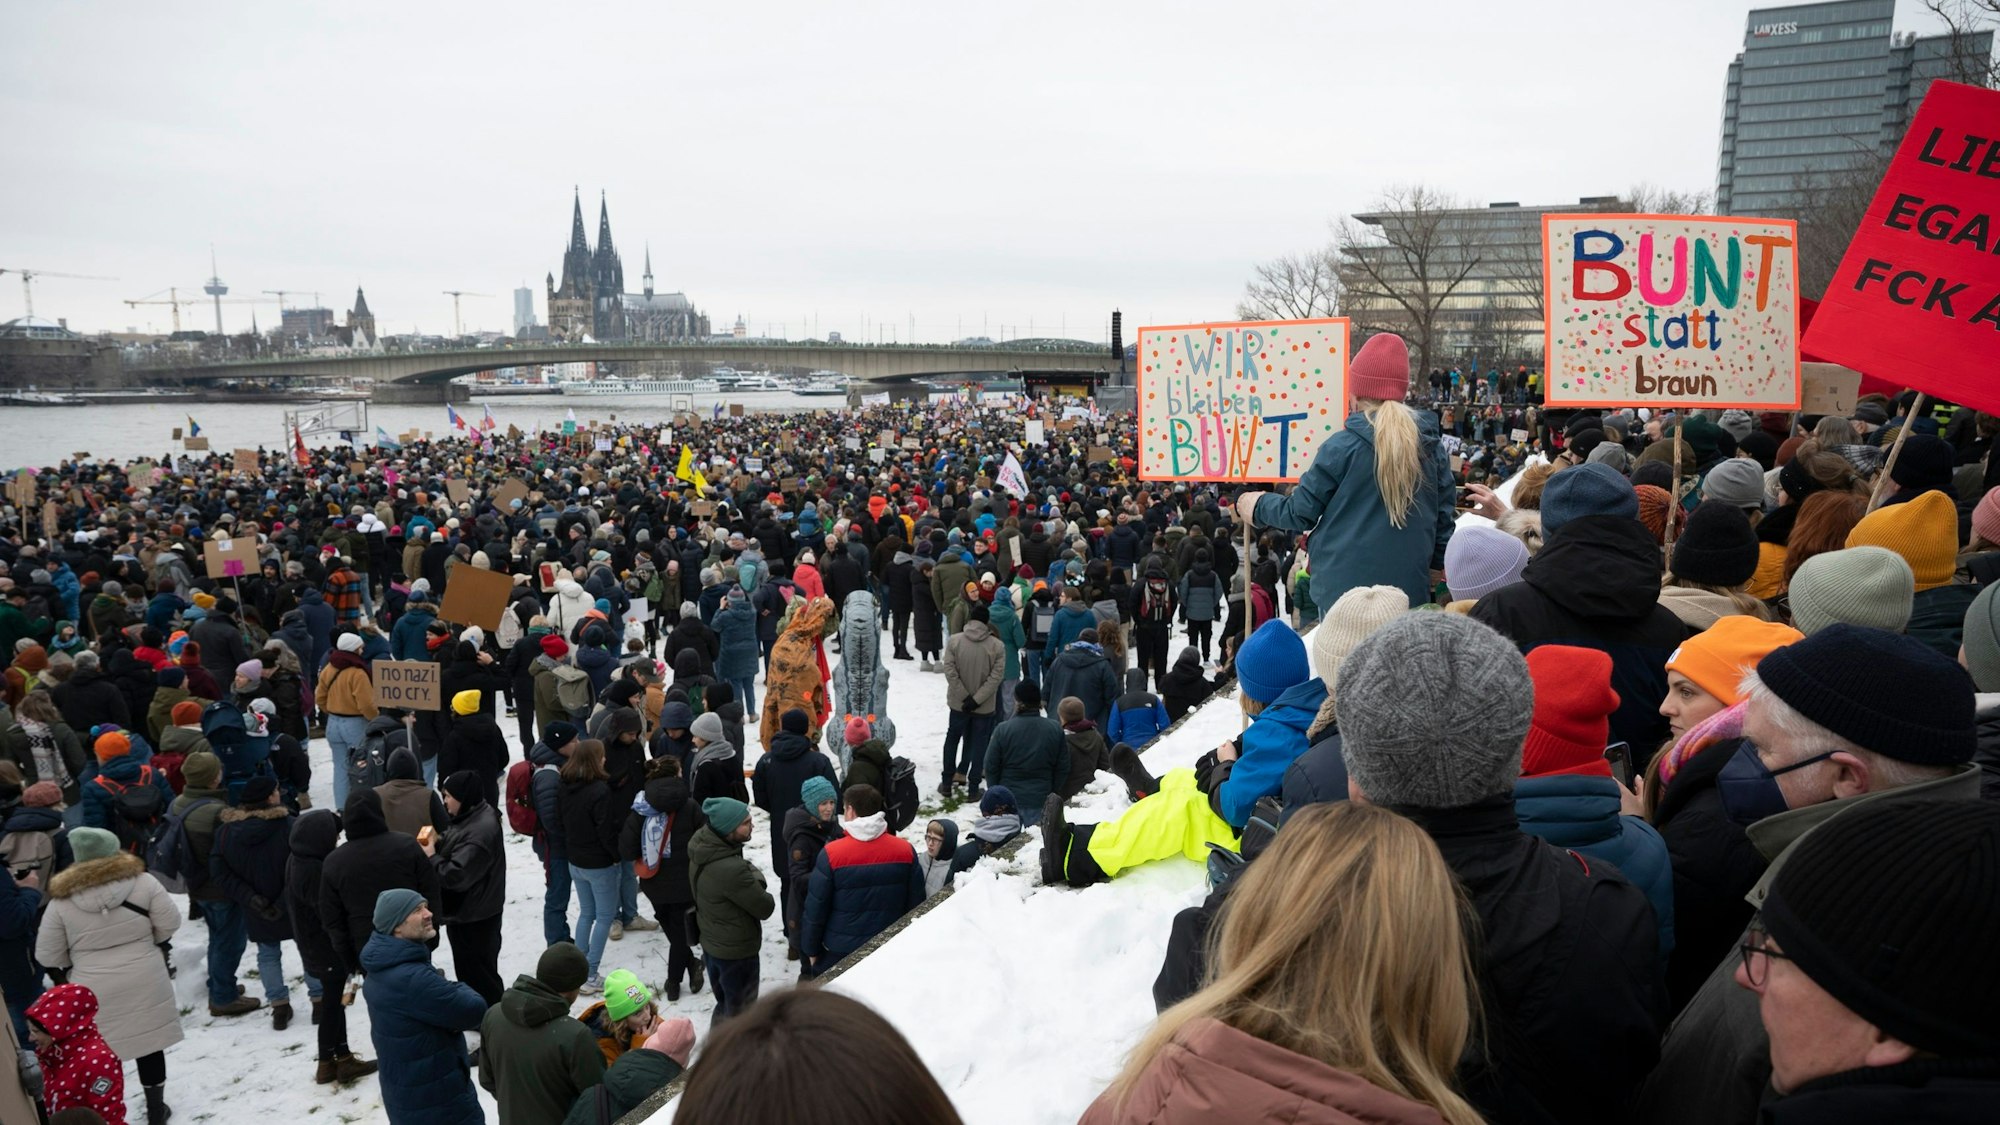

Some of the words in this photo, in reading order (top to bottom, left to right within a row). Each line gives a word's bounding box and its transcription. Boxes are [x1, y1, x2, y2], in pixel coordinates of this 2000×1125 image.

[1754, 21, 1798, 36] LANXESS
[1883, 193, 2000, 256] EGA
[1573, 229, 1792, 312] BUNT
[1853, 258, 1970, 319] FCK
[1622, 306, 1721, 351] statt
[1184, 330, 1264, 380] WIR
[1635, 355, 1717, 396] braun
[1167, 375, 1263, 416] bleiben
[1170, 412, 1308, 480] BUNT
[381, 667, 401, 681] no
[381, 686, 402, 700] no
